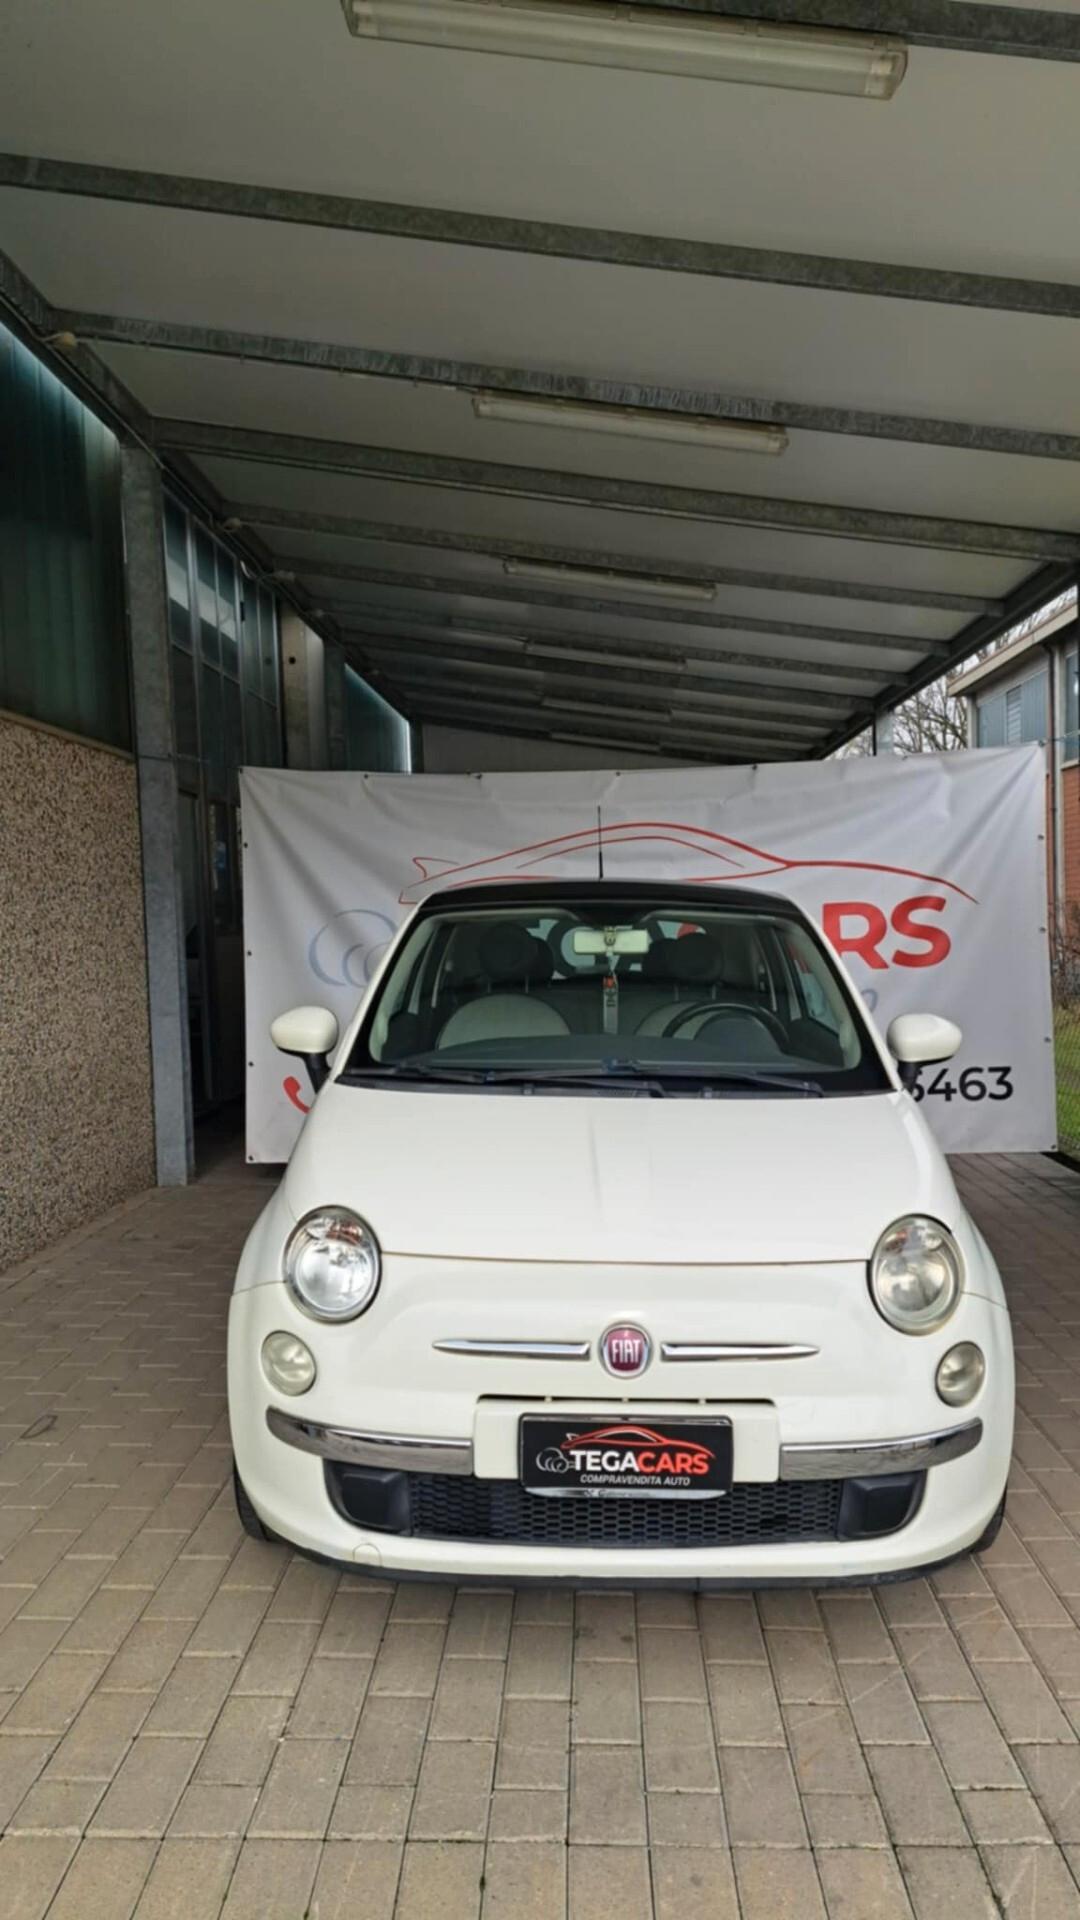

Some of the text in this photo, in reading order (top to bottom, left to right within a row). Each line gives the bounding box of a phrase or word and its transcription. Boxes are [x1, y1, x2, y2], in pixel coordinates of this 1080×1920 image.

[612, 1339, 641, 1364] FIAT
[569, 1450, 710, 1475] TEGACARS
[580, 1473, 691, 1487] COMPRAVENDITA AUTO
